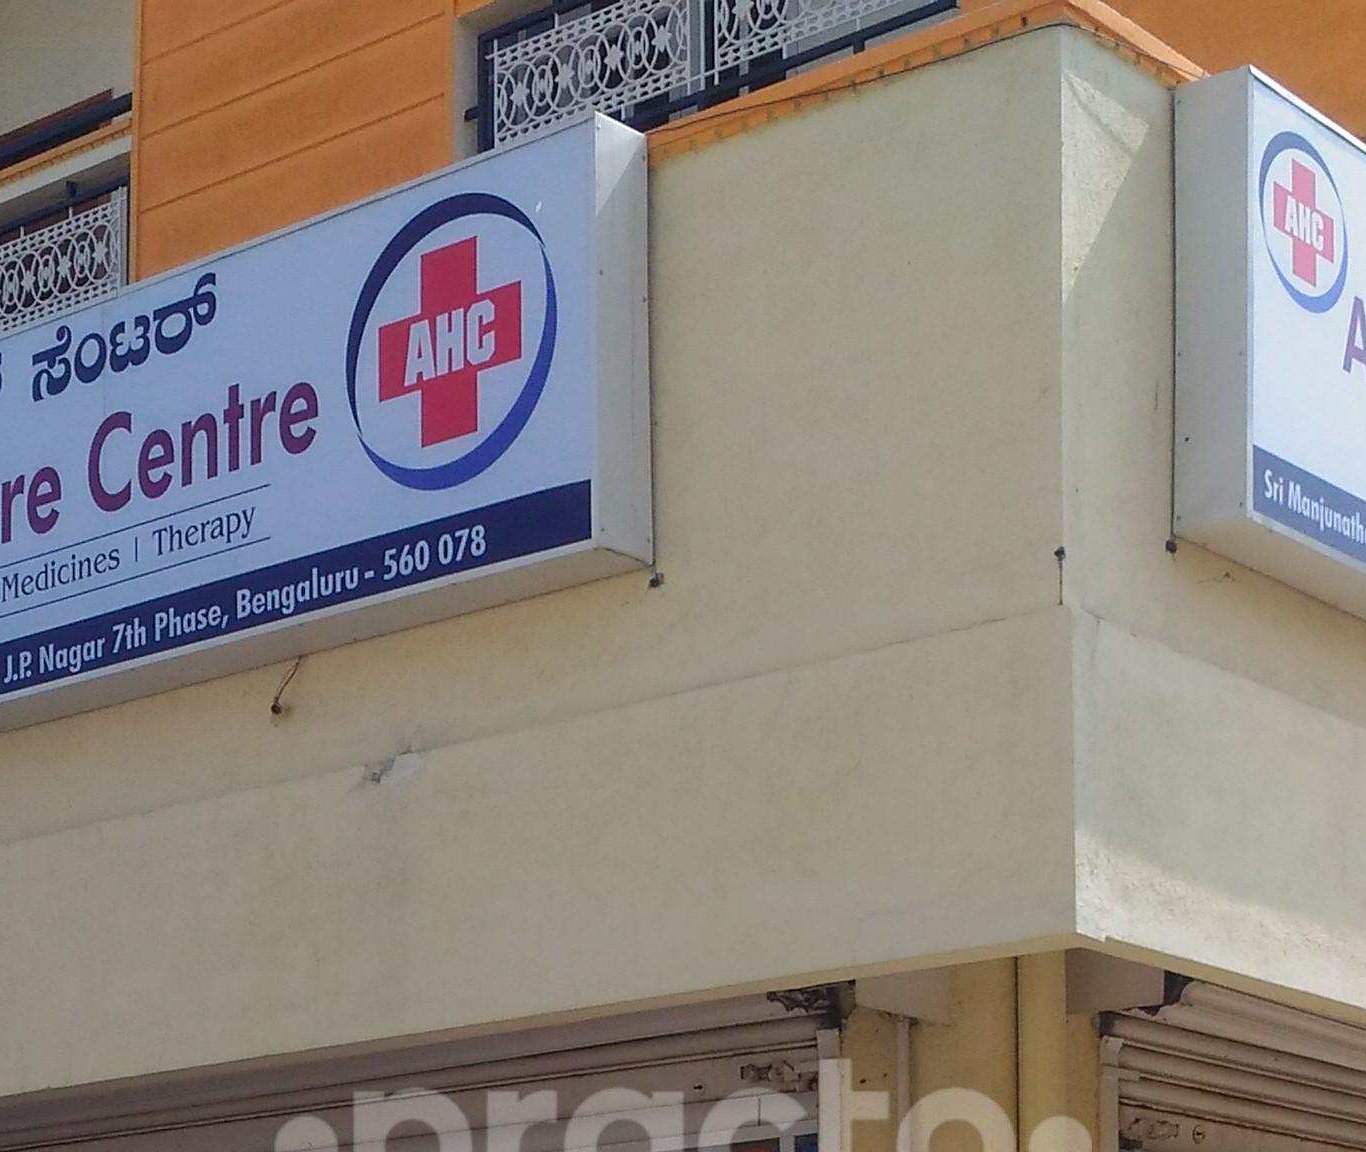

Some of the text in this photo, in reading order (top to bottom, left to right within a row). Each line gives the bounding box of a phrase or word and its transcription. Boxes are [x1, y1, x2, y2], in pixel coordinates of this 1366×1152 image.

[1285, 194, 1325, 252] AHC
[31, 272, 217, 401] ಸೆಂಟರ್
[404, 300, 496, 387] AHC
[87, 381, 319, 512] Centre
[1264, 469, 1284, 504] Sri
[1, 546, 121, 602] Medicines
[152, 506, 257, 557] Therapy
[38, 634, 105, 684] Nagar
[112, 618, 147, 654] 7th
[154, 603, 229, 642] Phase,
[236, 565, 360, 620] Bengaluru
[383, 540, 430, 581] 560
[438, 524, 486, 565] 078
